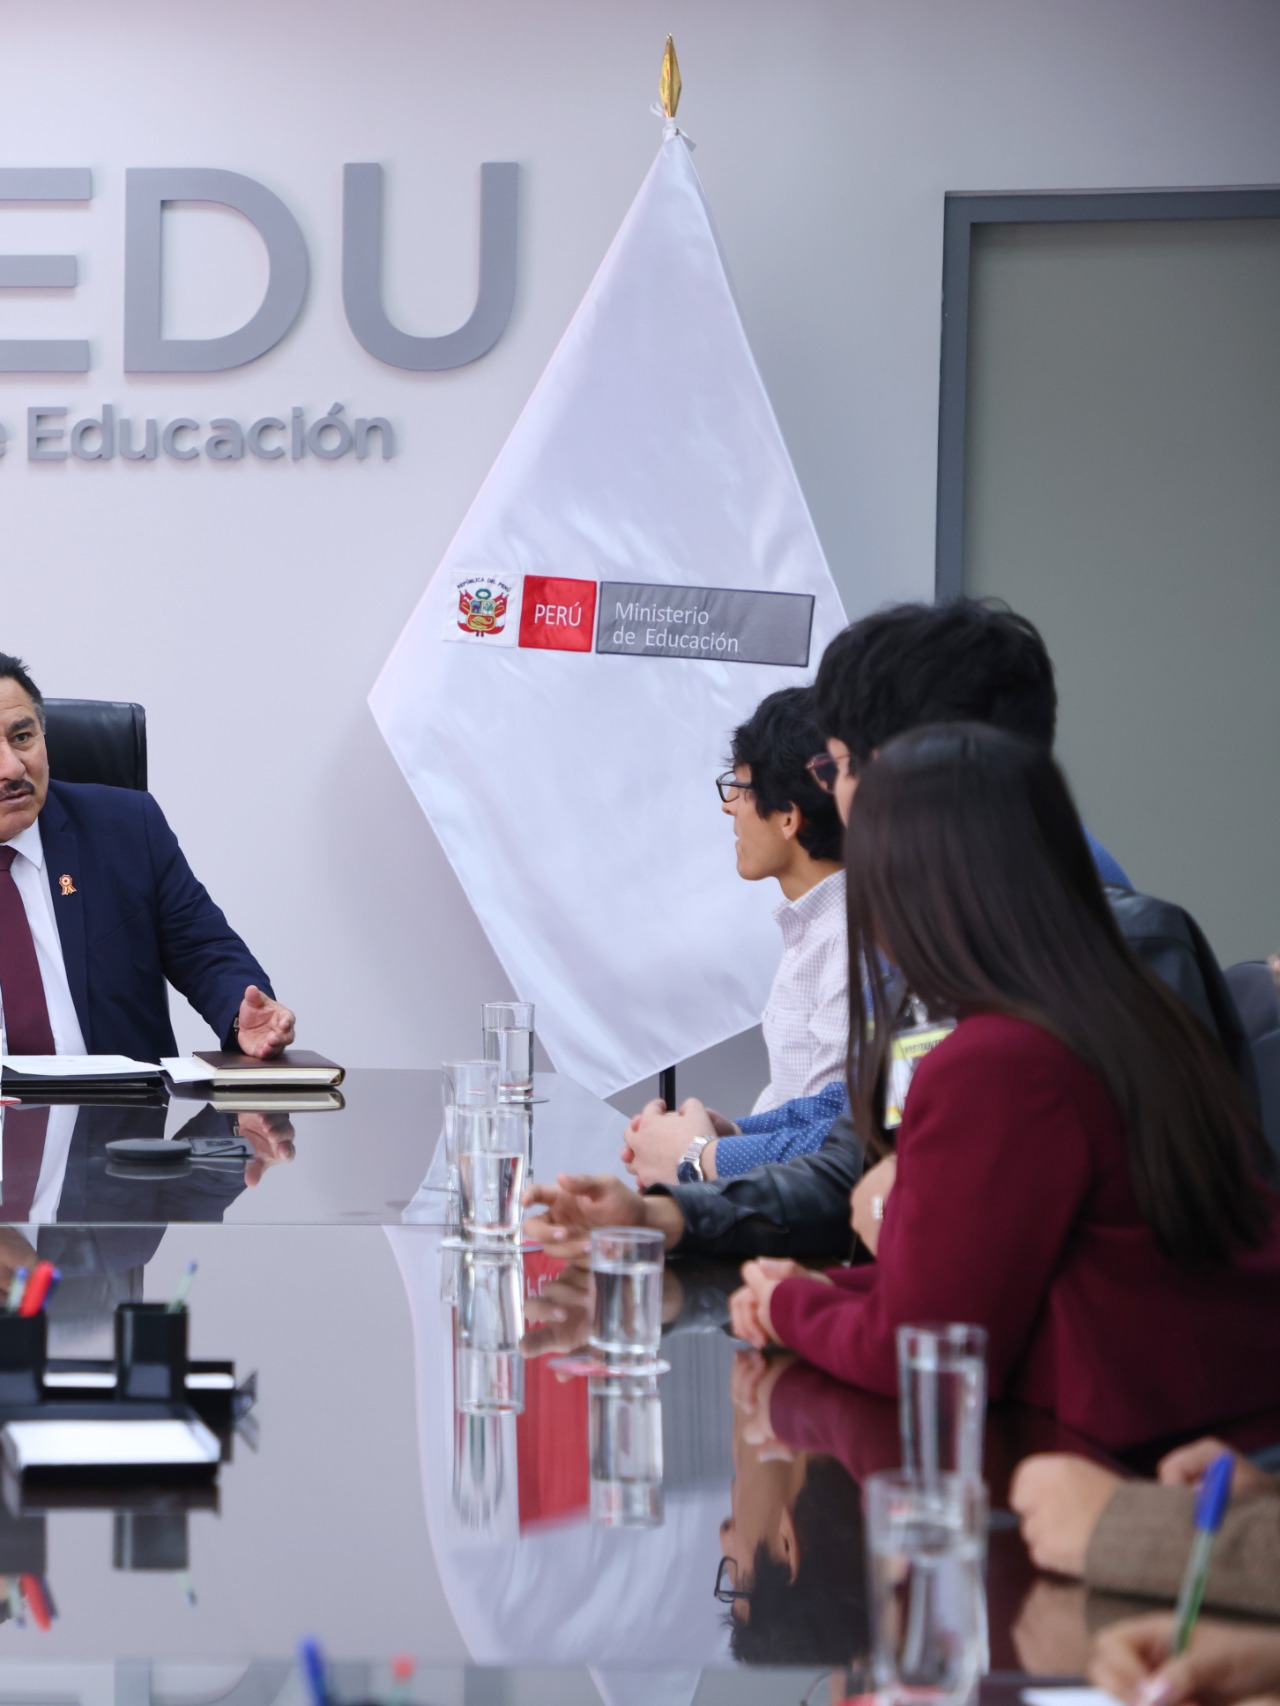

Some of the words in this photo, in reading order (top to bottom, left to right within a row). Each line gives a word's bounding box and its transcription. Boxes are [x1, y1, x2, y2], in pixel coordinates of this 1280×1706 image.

[27, 402, 395, 461] Educación
[534, 601, 582, 627] PERÚ
[615, 601, 709, 625] Ministerio
[613, 625, 635, 645] de
[645, 628, 738, 652] Educación
